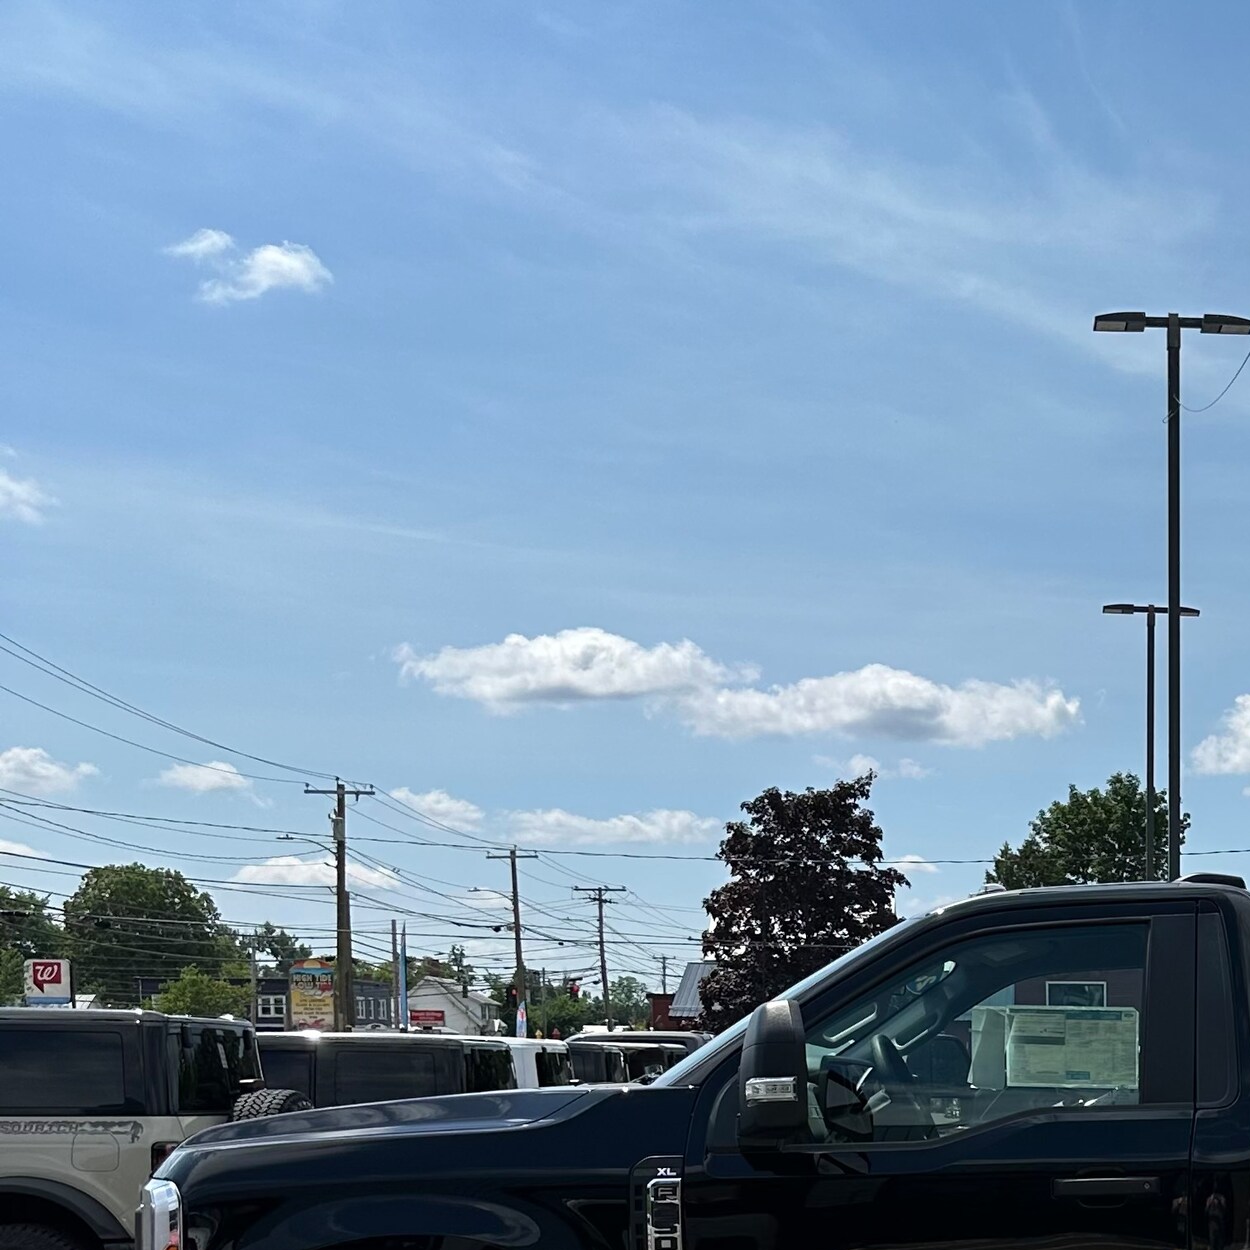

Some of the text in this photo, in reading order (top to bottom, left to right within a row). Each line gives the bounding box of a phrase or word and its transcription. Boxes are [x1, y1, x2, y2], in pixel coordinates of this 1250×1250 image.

[35, 965, 58, 980] W
[293, 974, 332, 982] HIGH TIDE
[657, 1167, 677, 1176] XL
